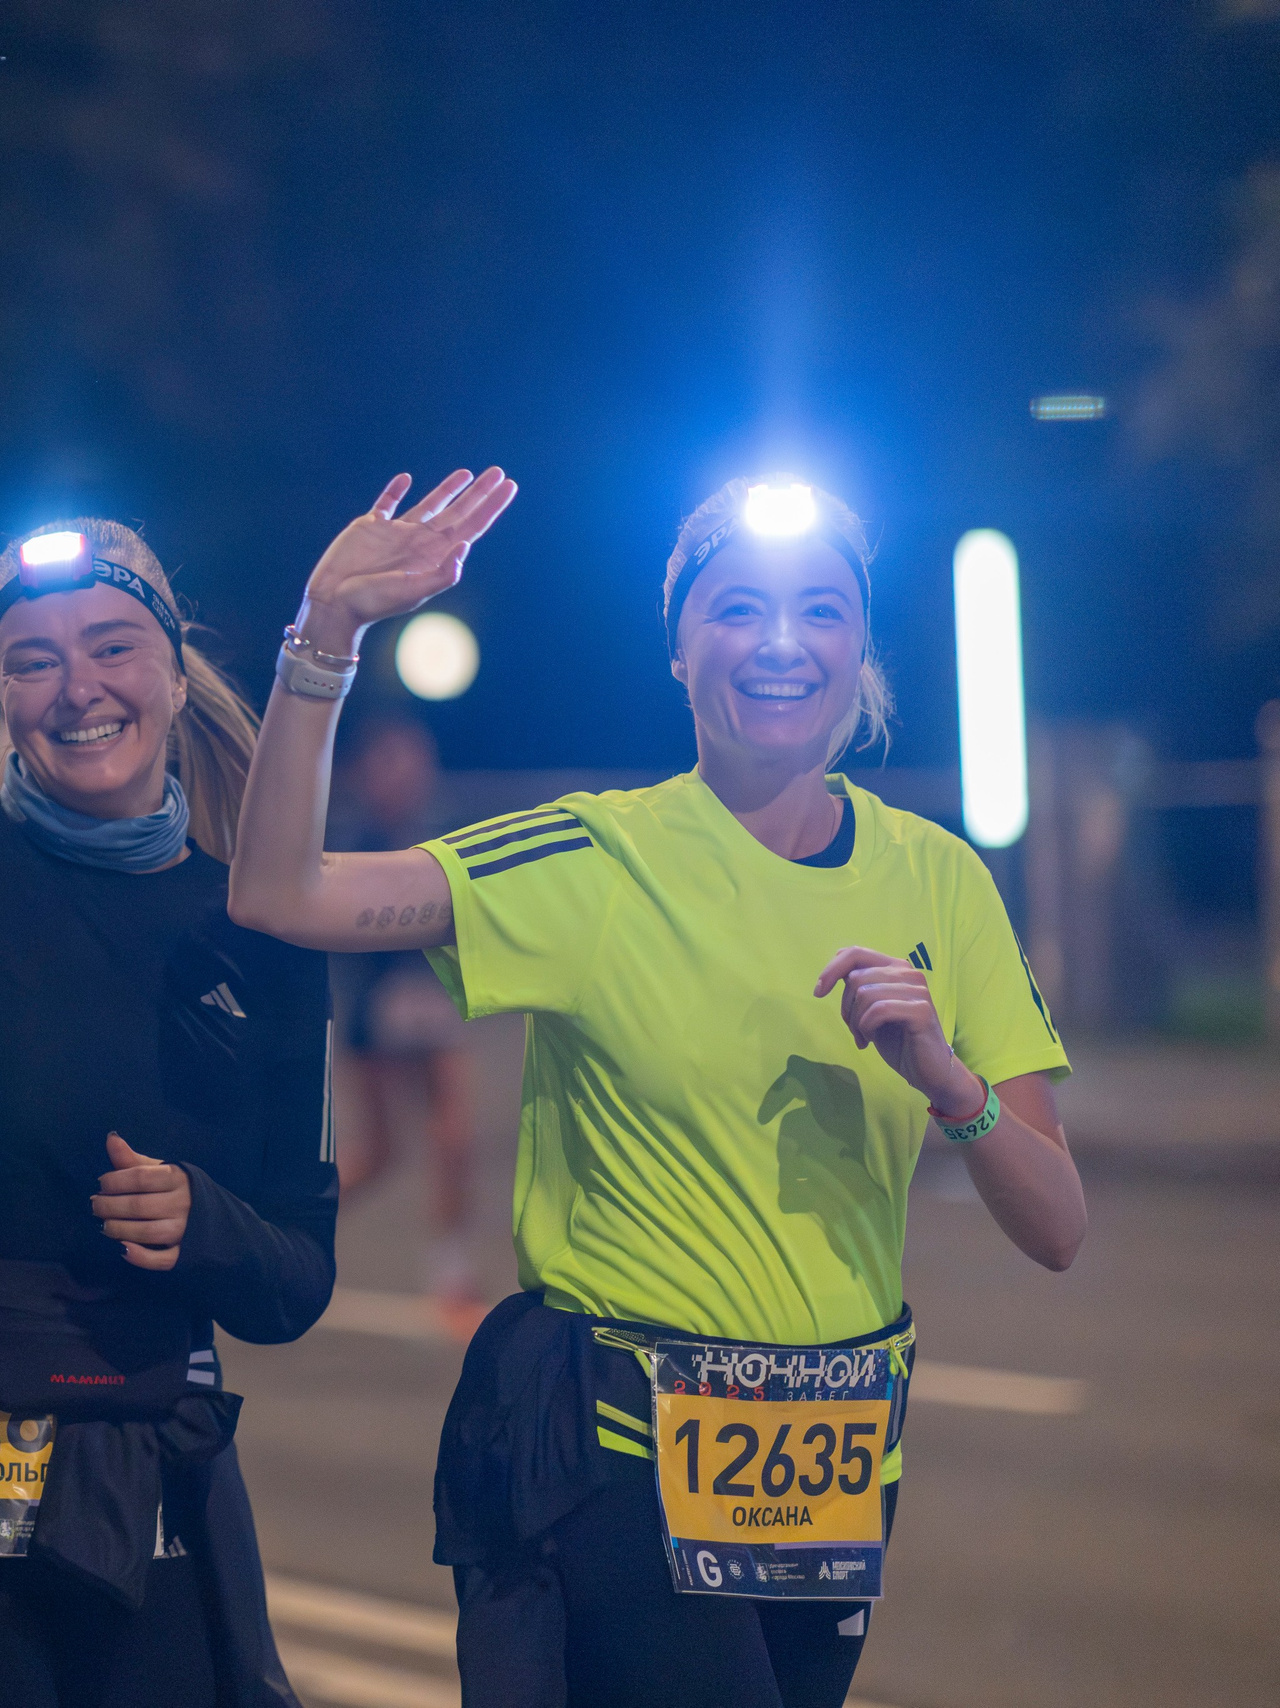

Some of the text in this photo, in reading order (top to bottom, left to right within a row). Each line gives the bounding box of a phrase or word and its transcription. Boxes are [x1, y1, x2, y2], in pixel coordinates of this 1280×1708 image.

[944, 1109, 996, 1140] 12635
[50, 1374, 126, 1385] MAMMUT
[691, 1347, 877, 1388] НОЧНОЙ
[674, 1380, 765, 1401] 2025
[787, 1390, 848, 1401] ЗАБЕГ
[675, 1419, 877, 1498] 12635
[732, 1506, 814, 1528] ОКСАНА
[696, 1550, 723, 1588] G
